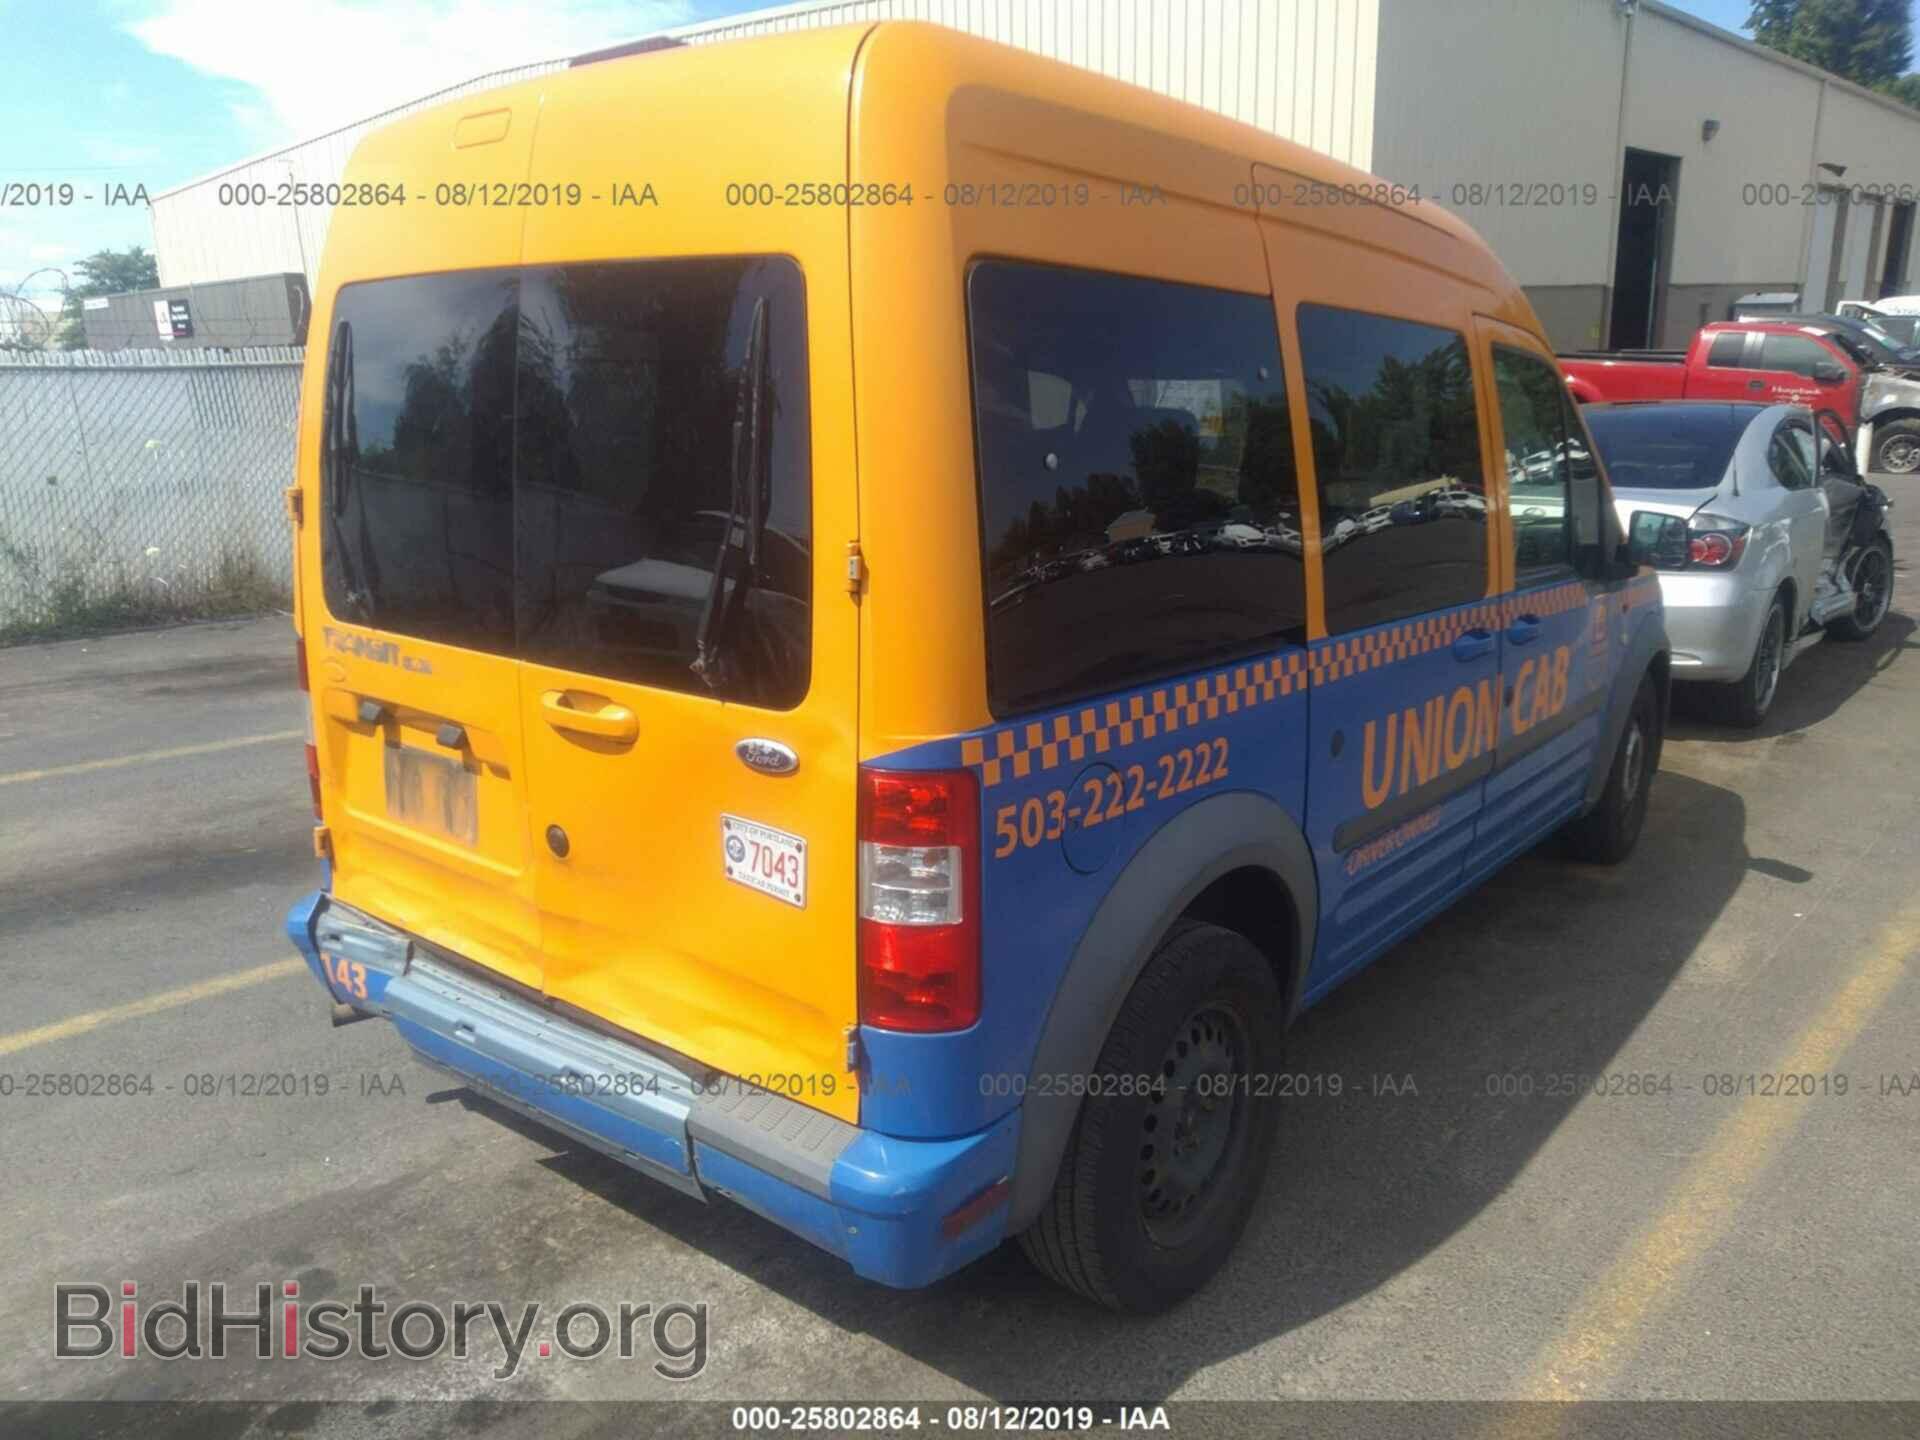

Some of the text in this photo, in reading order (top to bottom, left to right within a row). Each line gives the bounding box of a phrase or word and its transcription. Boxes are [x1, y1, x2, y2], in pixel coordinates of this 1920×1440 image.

[1363, 645, 1570, 810] UNION CAB
[995, 738, 1229, 858] 503-222-2222
[750, 840, 799, 888] 7043
